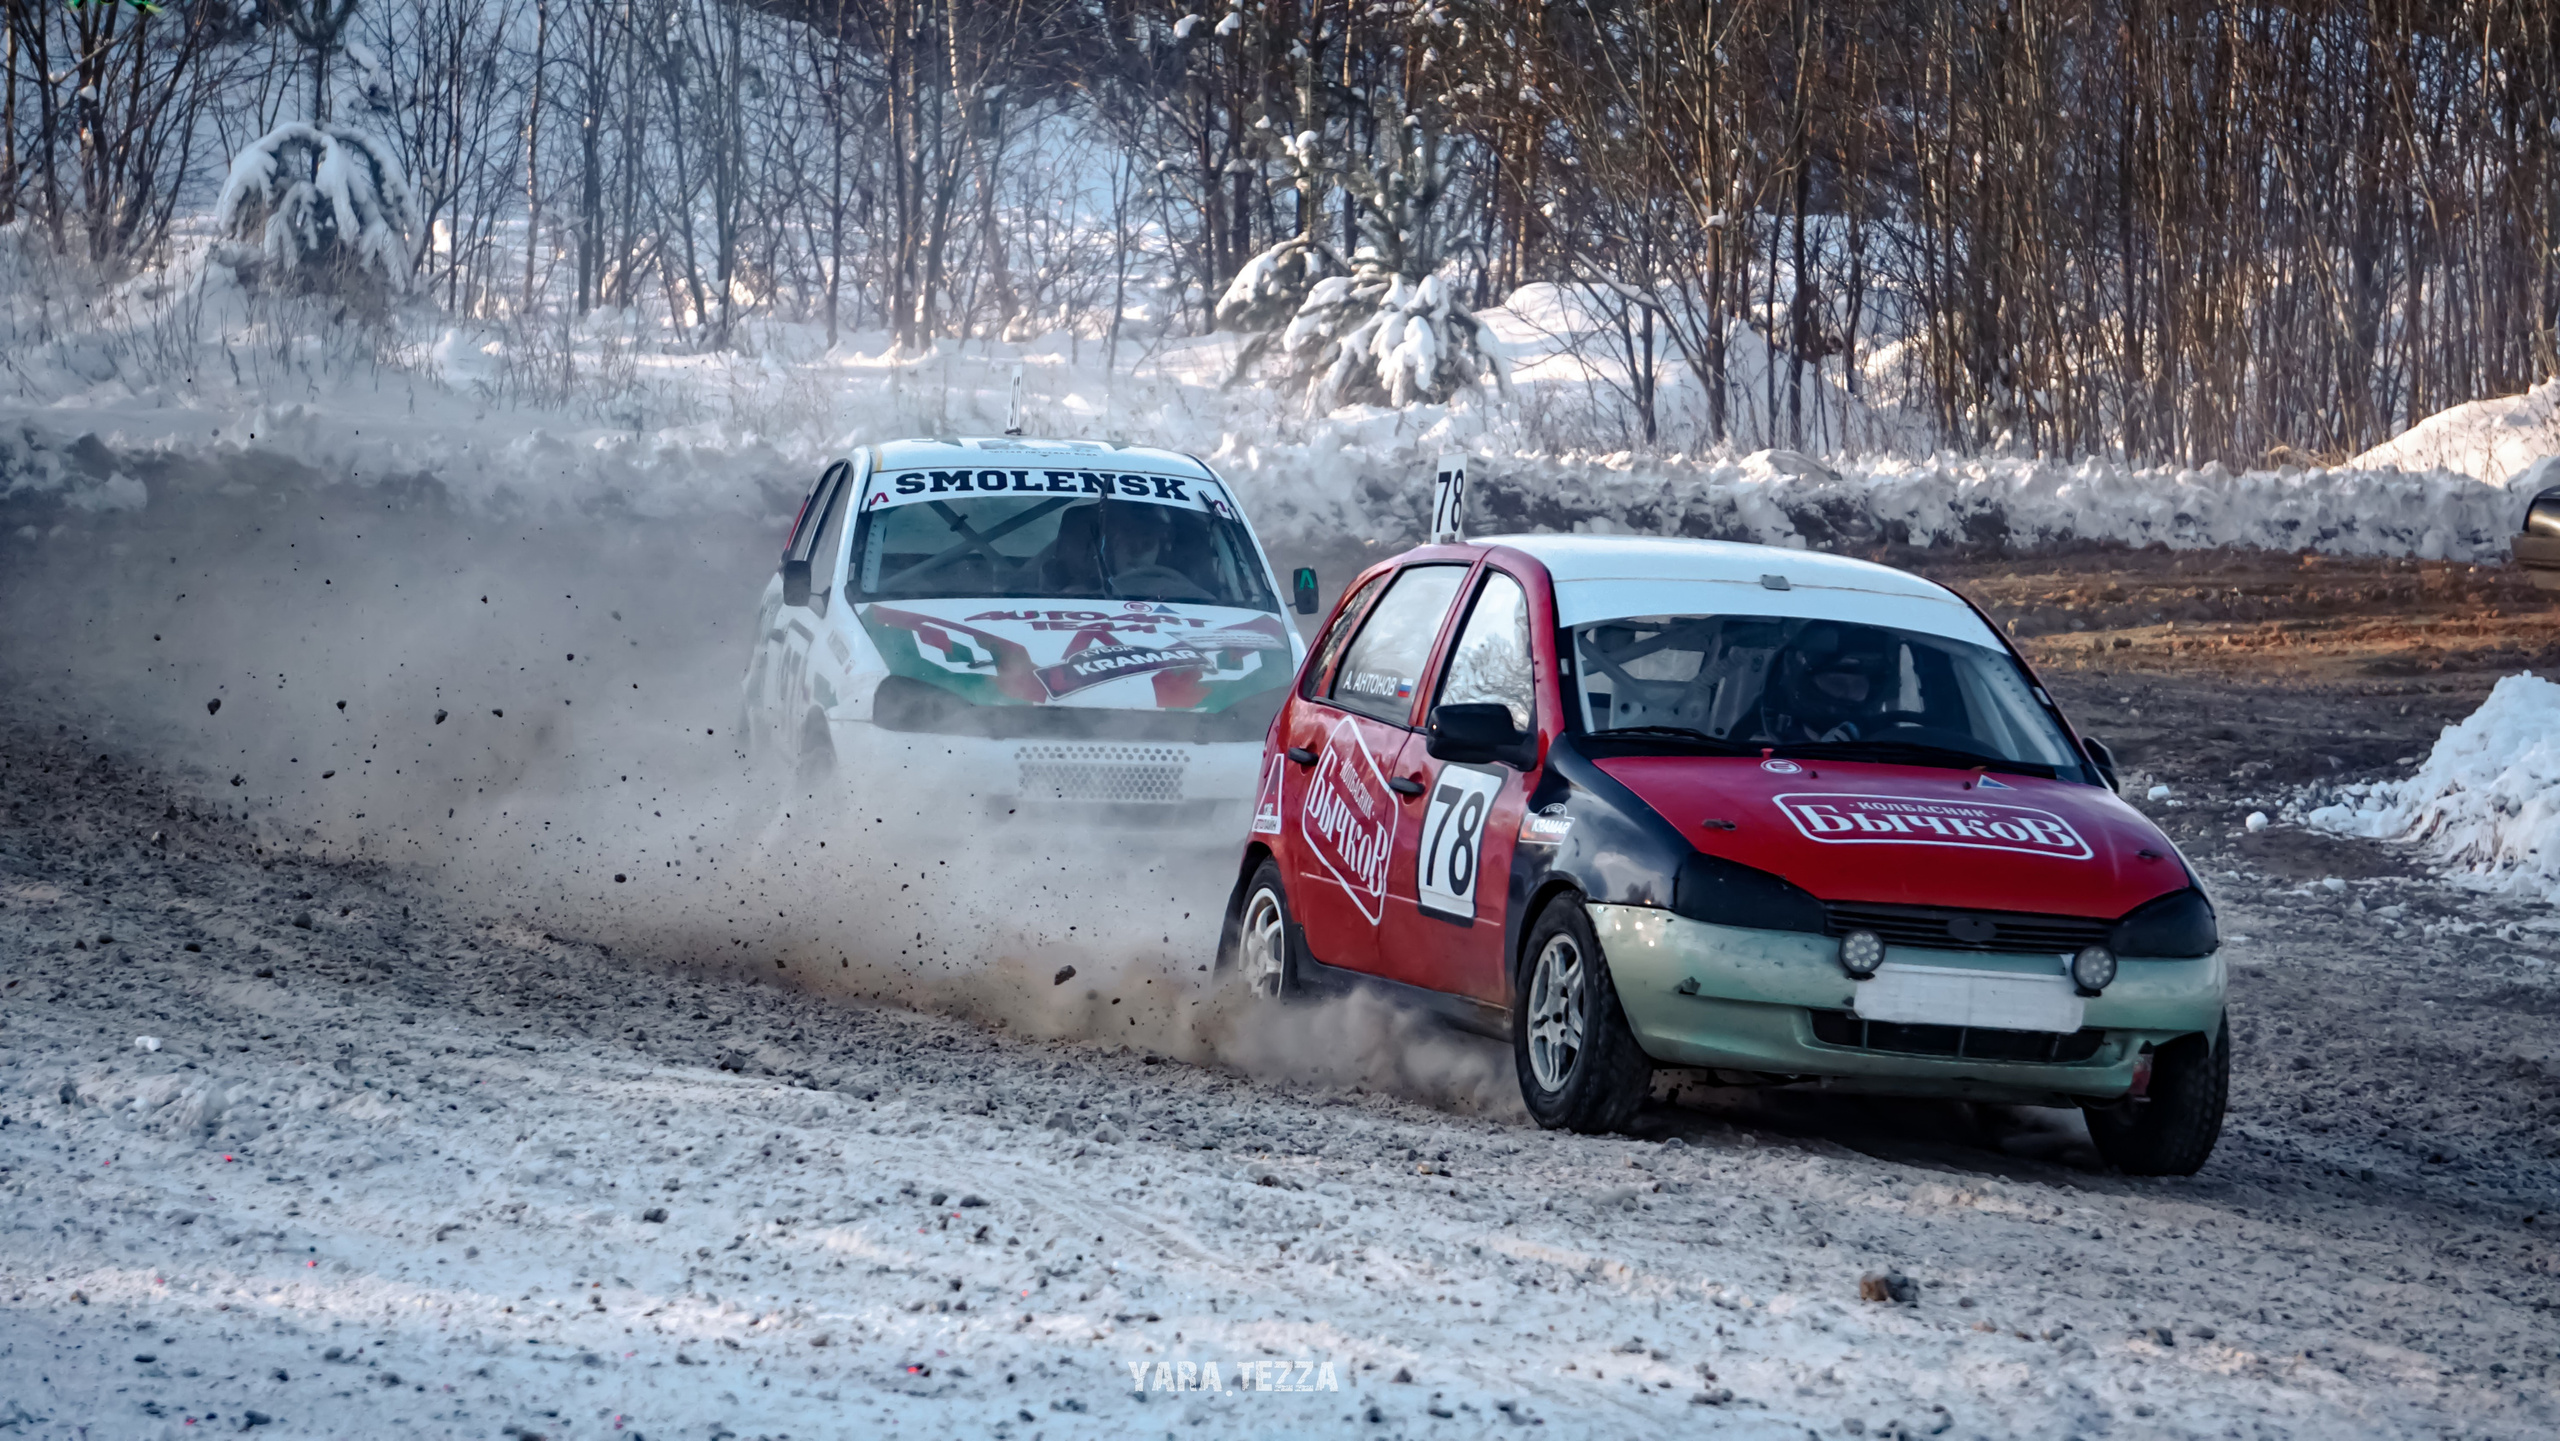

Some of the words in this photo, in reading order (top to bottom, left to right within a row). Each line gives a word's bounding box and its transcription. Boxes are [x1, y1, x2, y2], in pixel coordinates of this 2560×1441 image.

[895, 470, 1191, 502] SMOLENSK
[1436, 468, 1464, 533] 78
[1026, 621, 1158, 634] TEAM
[1073, 650, 1201, 676] KRAMAR
[1352, 672, 1398, 696] АНТОНОВ
[1856, 801, 1986, 818] КОЛБАСНИК
[1531, 818, 1571, 835] KRAMAR
[1427, 783, 1485, 896] 78
